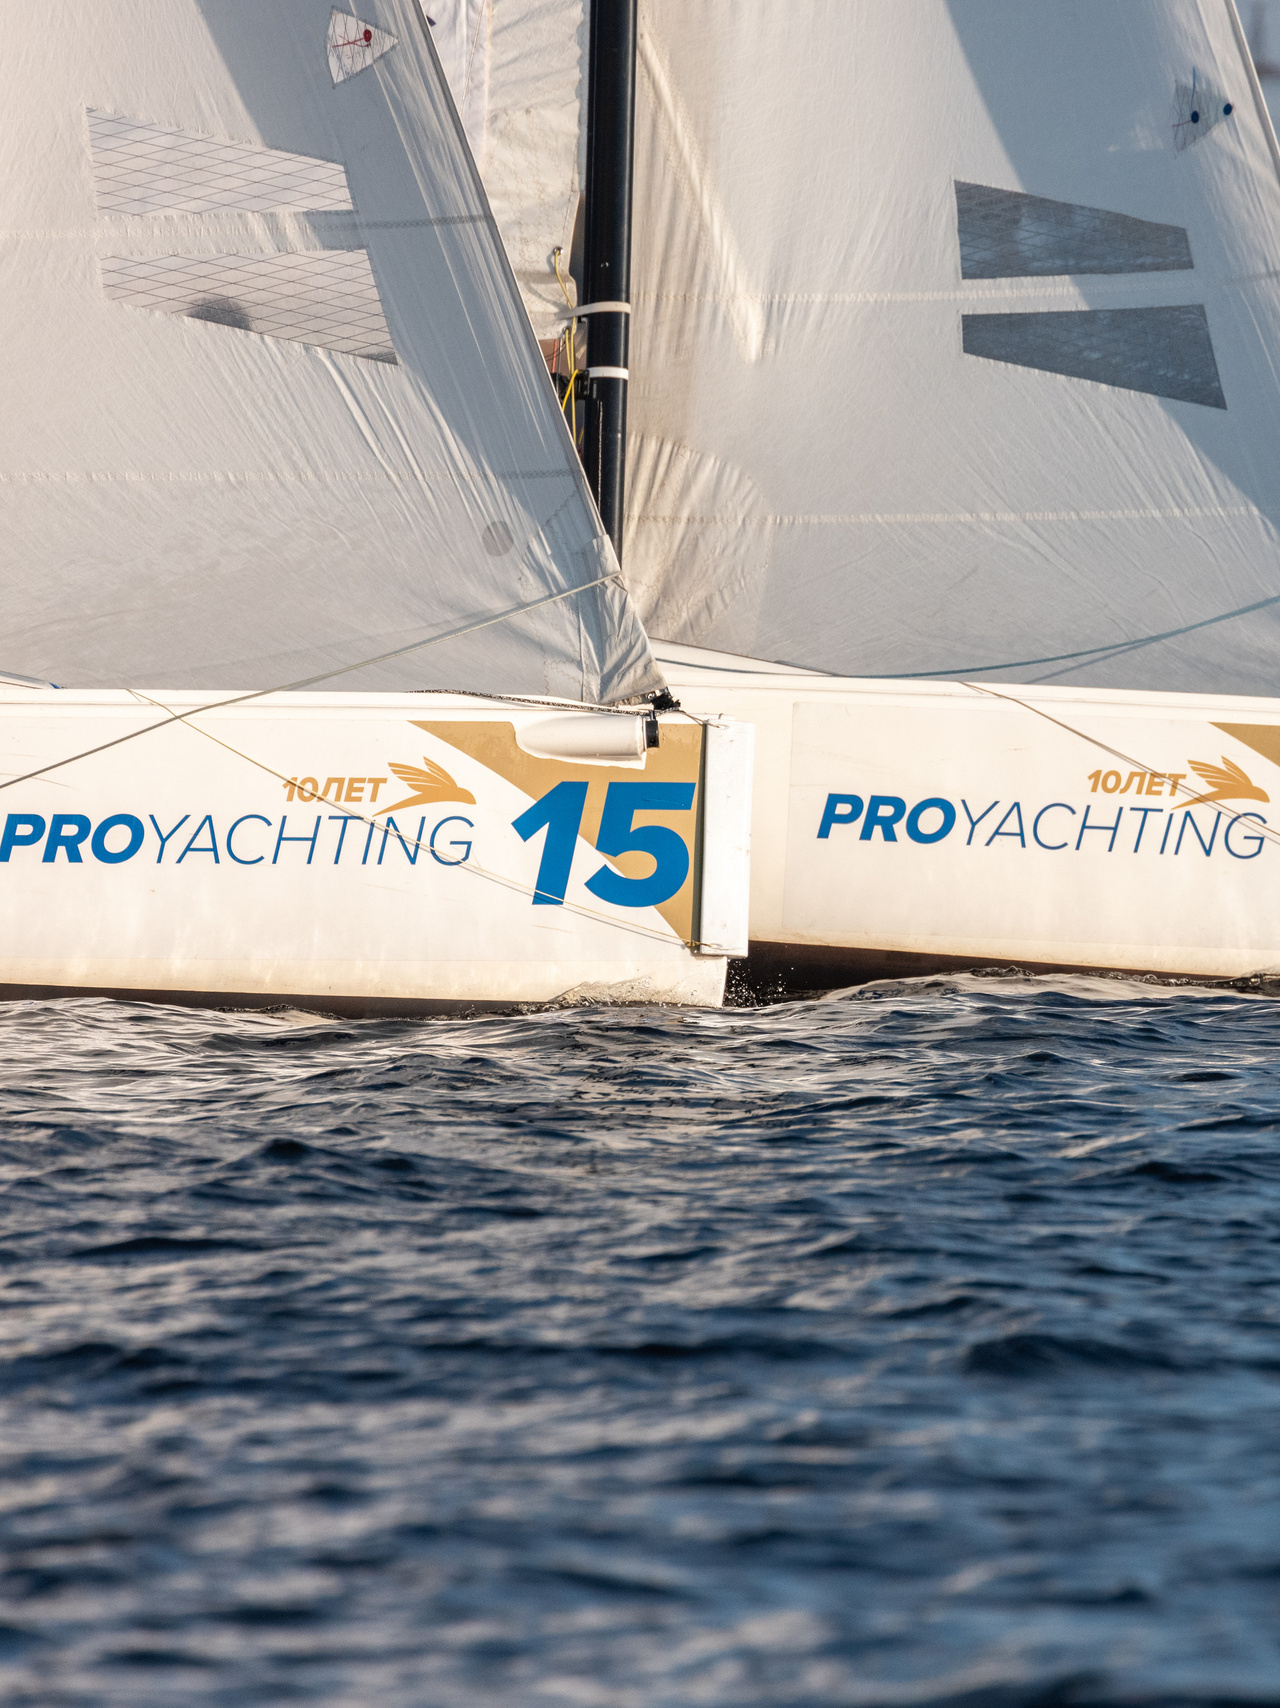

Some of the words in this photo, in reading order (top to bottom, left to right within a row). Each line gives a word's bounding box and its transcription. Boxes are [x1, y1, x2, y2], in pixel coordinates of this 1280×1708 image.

[0, 813, 475, 867] PROYACHTING
[511, 781, 696, 908] 15
[816, 793, 1268, 860] PROYACHTING
